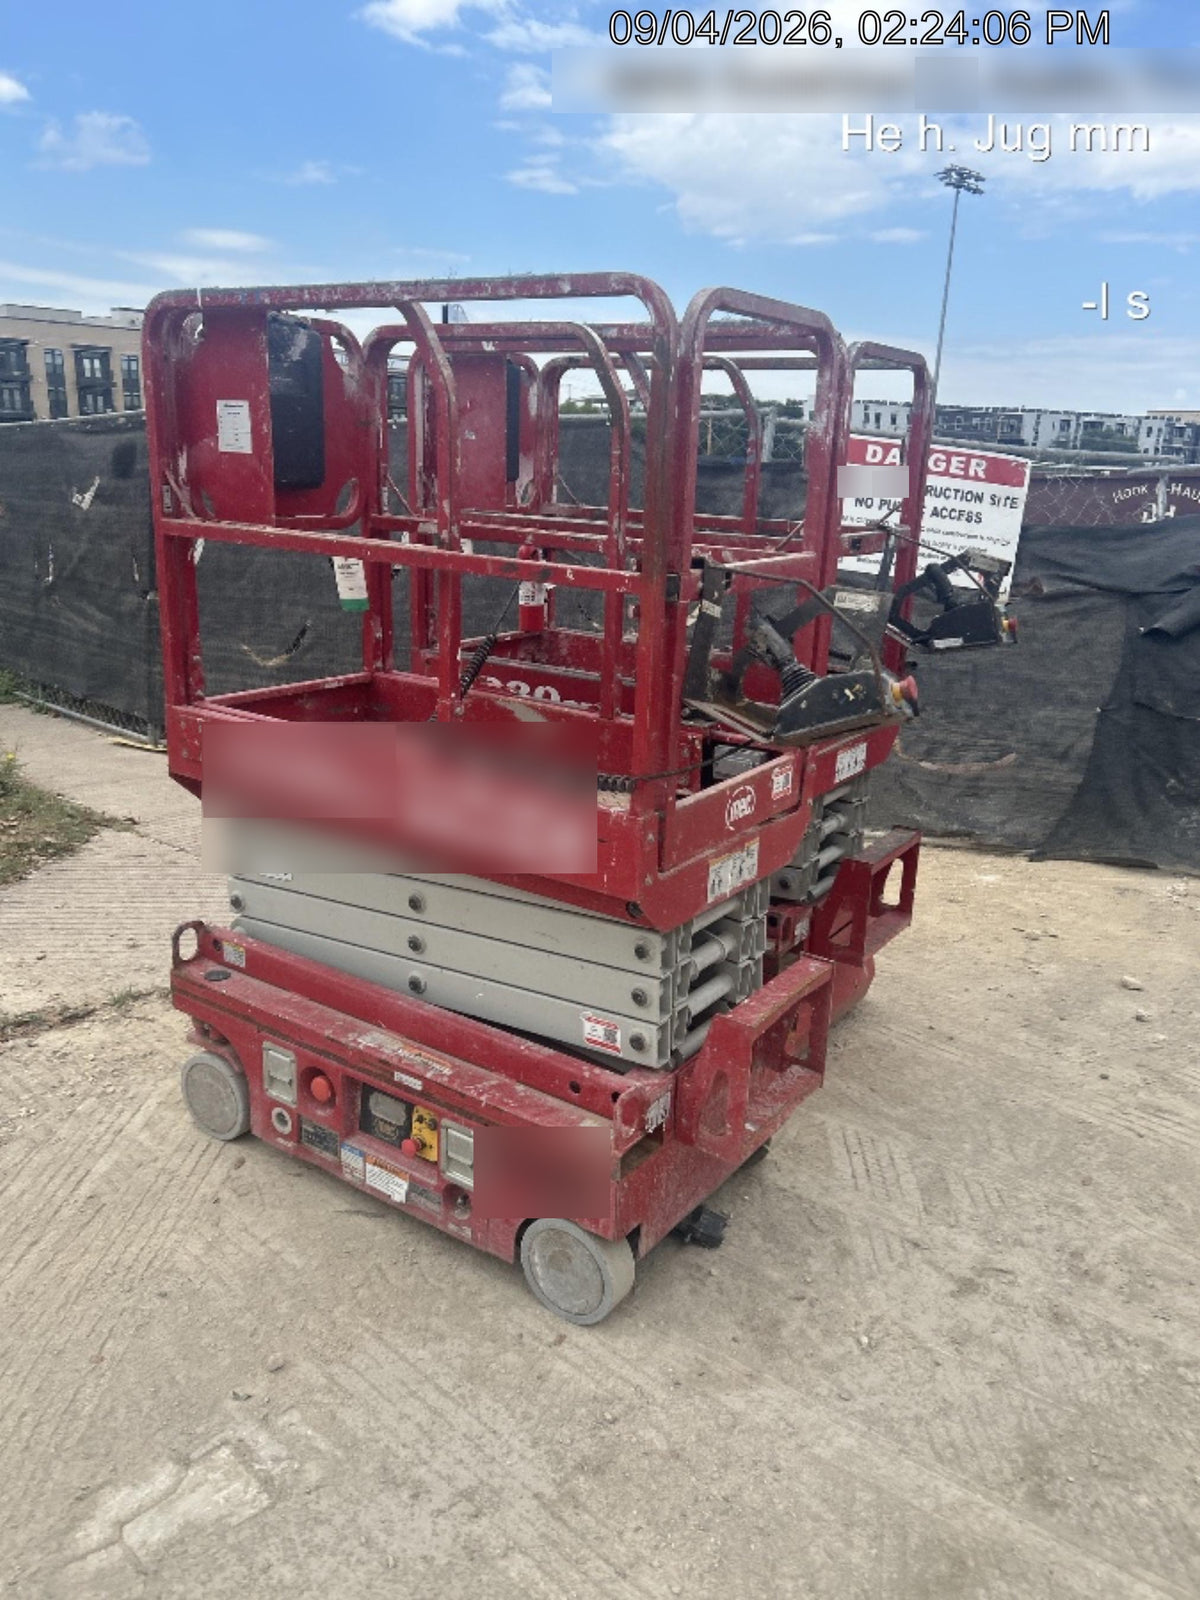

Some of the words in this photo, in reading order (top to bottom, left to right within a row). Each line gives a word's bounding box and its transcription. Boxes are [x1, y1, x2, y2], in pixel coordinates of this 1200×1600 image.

[865, 444, 986, 479] DAGER
[855, 498, 874, 509] NO
[930, 506, 982, 524] ACCESS
[990, 493, 1019, 509] SITE
